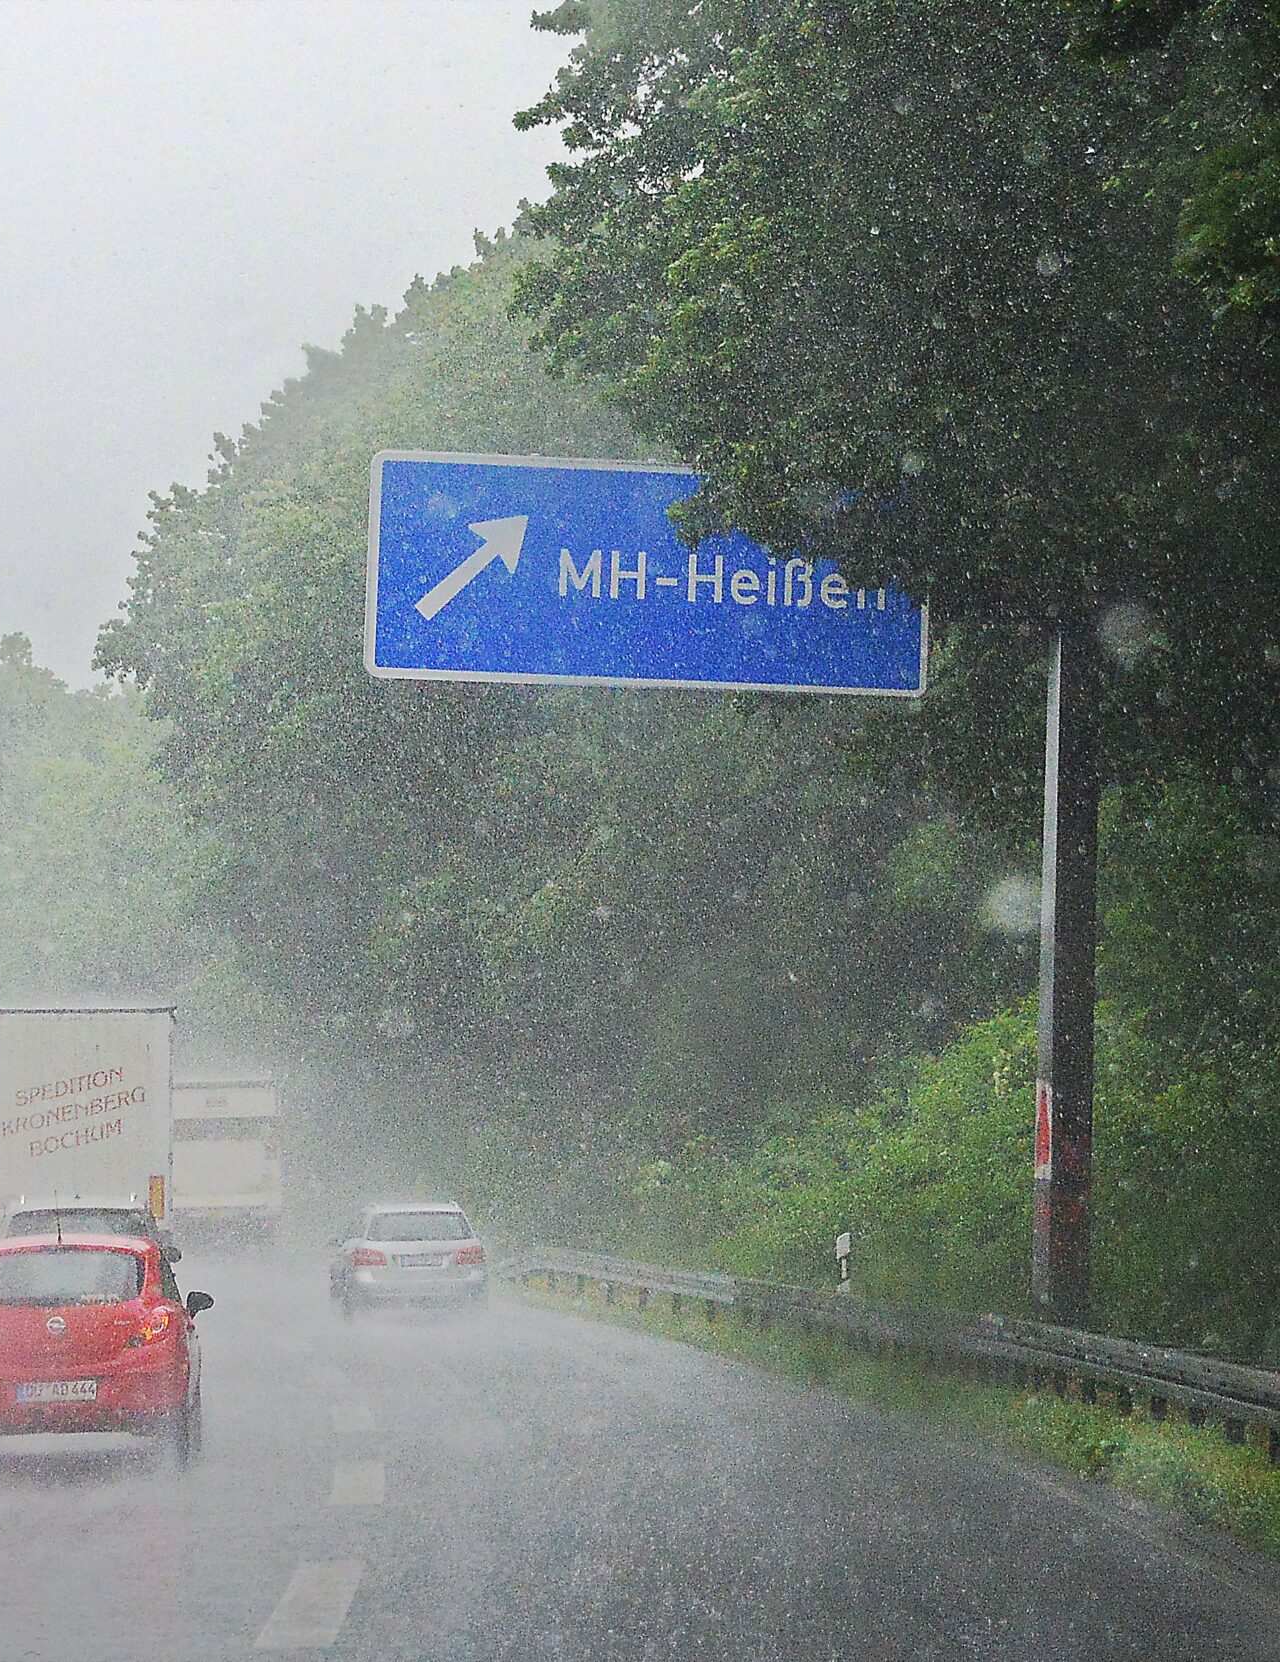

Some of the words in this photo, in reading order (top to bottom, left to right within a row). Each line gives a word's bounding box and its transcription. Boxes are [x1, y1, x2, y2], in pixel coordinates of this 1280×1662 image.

[15, 1066, 124, 1107] SPEDITION
[1, 1085, 146, 1137] KRONENBERG
[28, 1118, 124, 1157] BOCHUM
